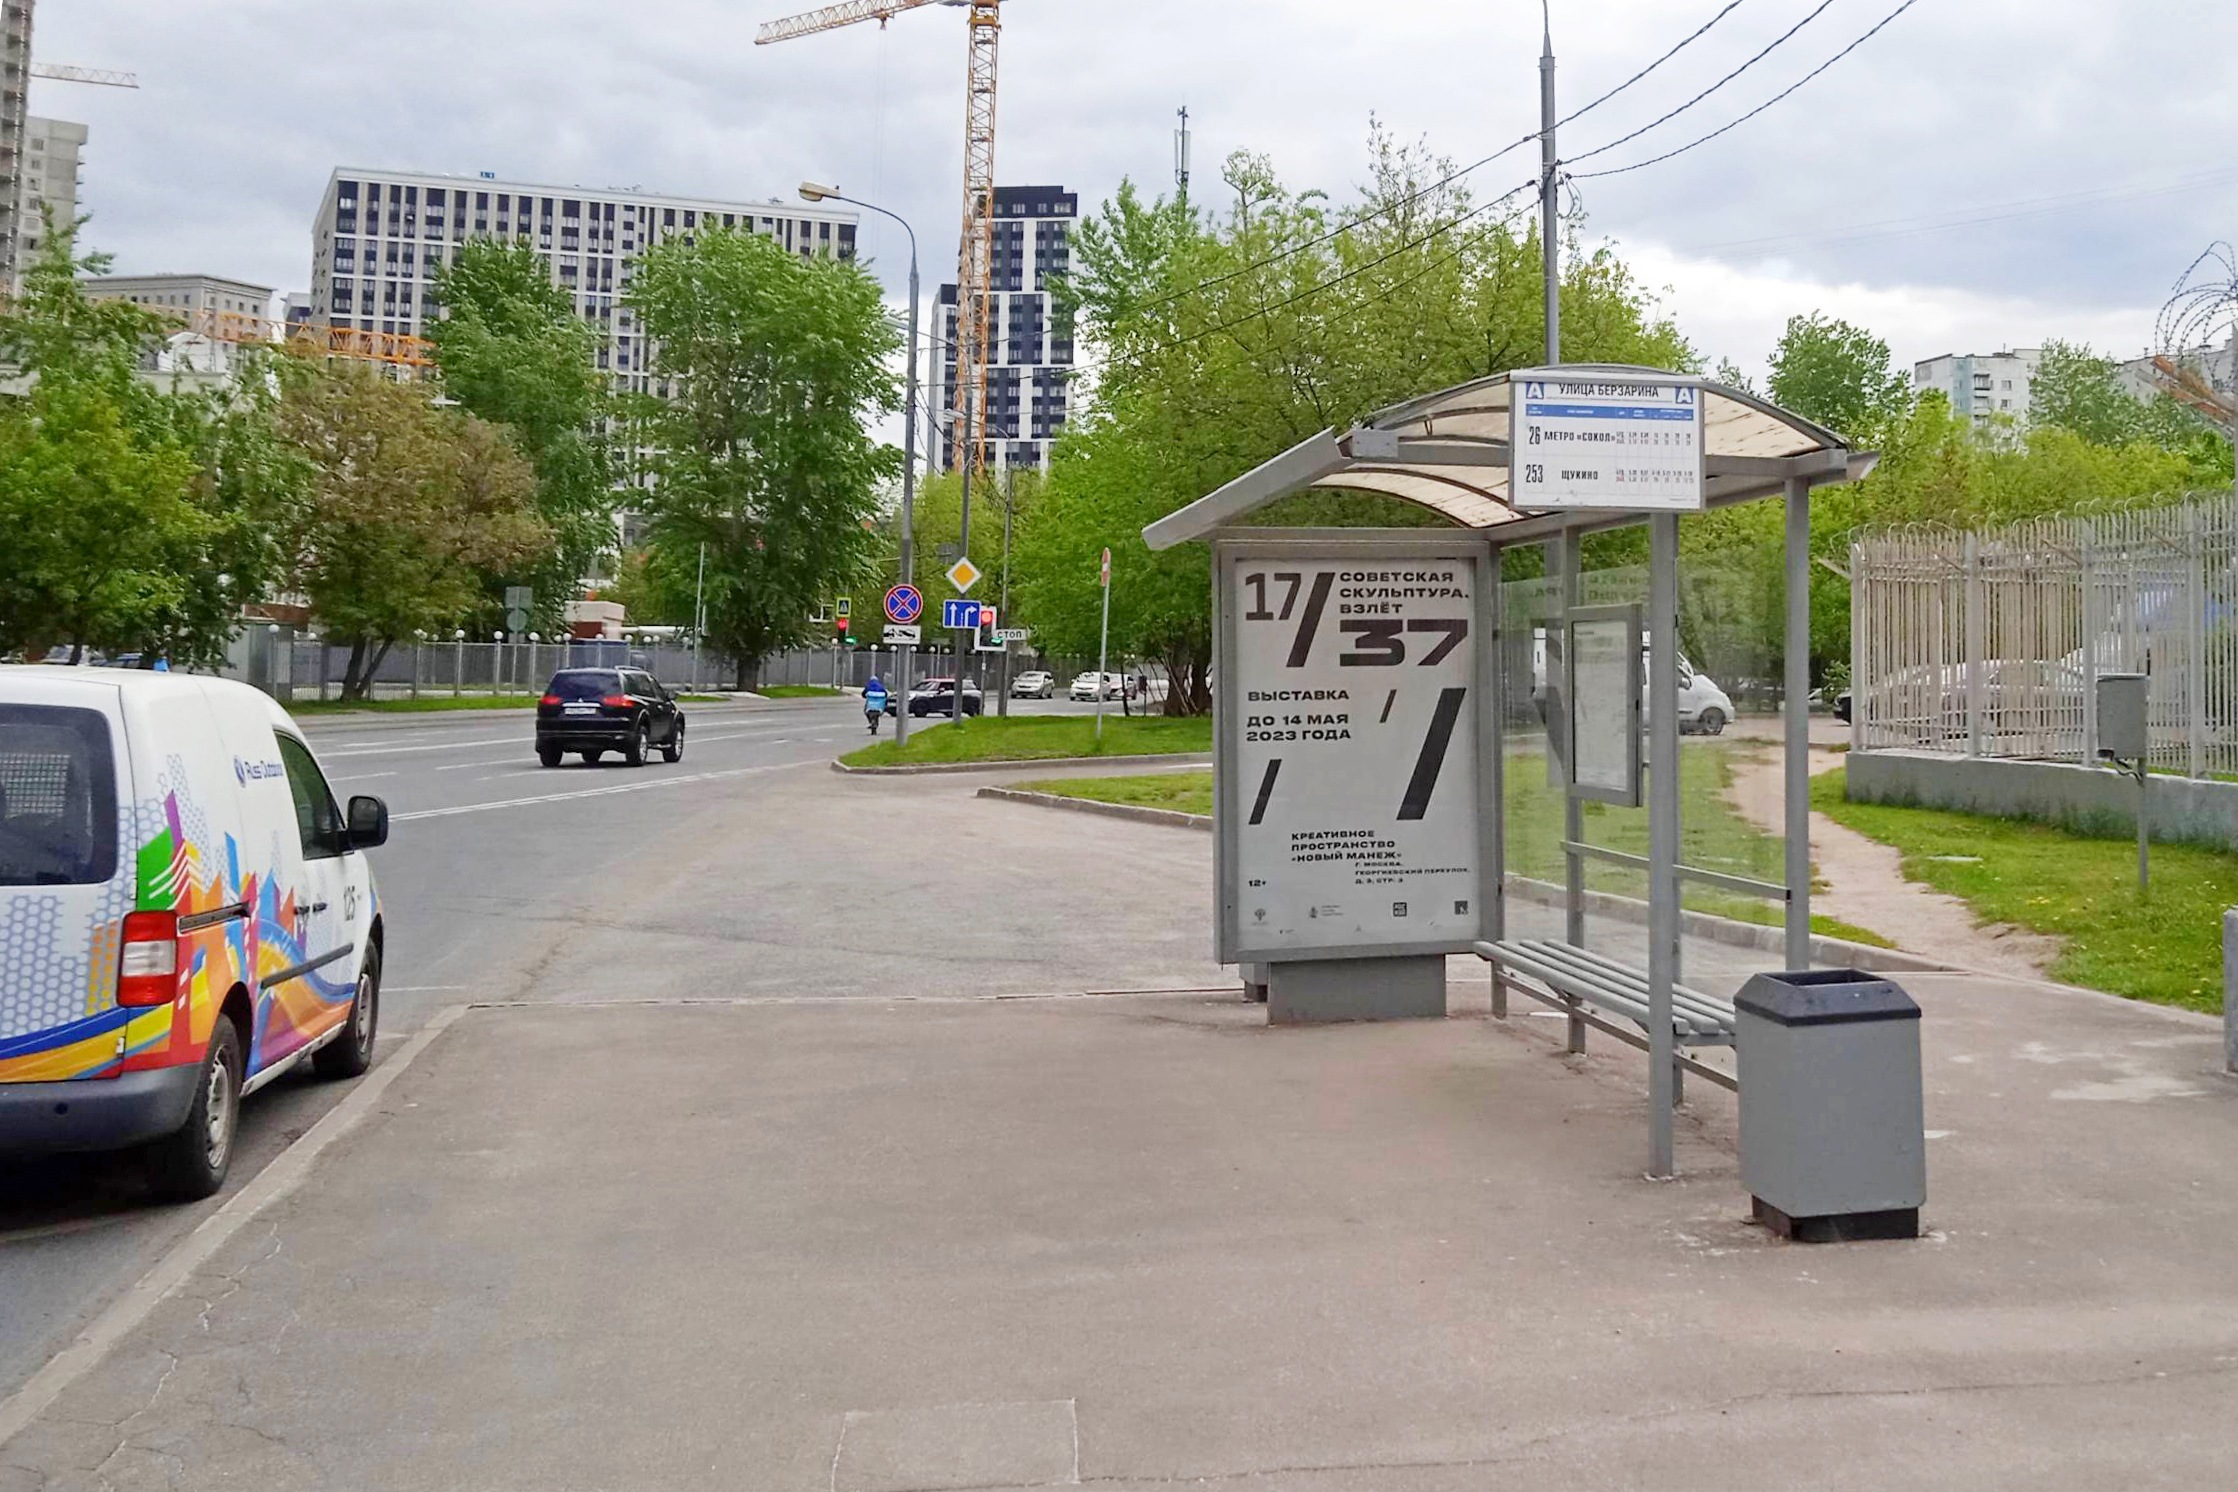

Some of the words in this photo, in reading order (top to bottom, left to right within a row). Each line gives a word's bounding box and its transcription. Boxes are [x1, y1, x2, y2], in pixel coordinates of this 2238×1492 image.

[1559, 383, 1595, 396] УЛИЦА
[1598, 384, 1659, 397] БЕРЗАРИНА
[1529, 426, 1541, 445] 26
[1544, 431, 1575, 441] МЕТРО
[1577, 432, 1615, 442] «СОКОЛ»
[1526, 464, 1543, 483] 253
[1561, 470, 1598, 481] ЩУКИНО
[1340, 572, 1454, 582] СОВЕТСКАЯ
[1340, 588, 1469, 598] СКУЛЬПТУРА.
[1340, 602, 1403, 614] ВЗЛЁТ
[1340, 619, 1468, 666] 37
[1248, 690, 1349, 701] ВЫСТАВКА
[1247, 716, 1275, 727] ДО
[1282, 715, 1302, 725] 14
[1307, 714, 1349, 725] МАЯ
[1246, 730, 1297, 741] 2023
[1302, 729, 1351, 740] ГОДА
[1291, 830, 1375, 841] КРЕАТИВНОЕ
[1291, 840, 1396, 851] ПРОСТРАНСТВО
[1248, 879, 1267, 887] 12+
